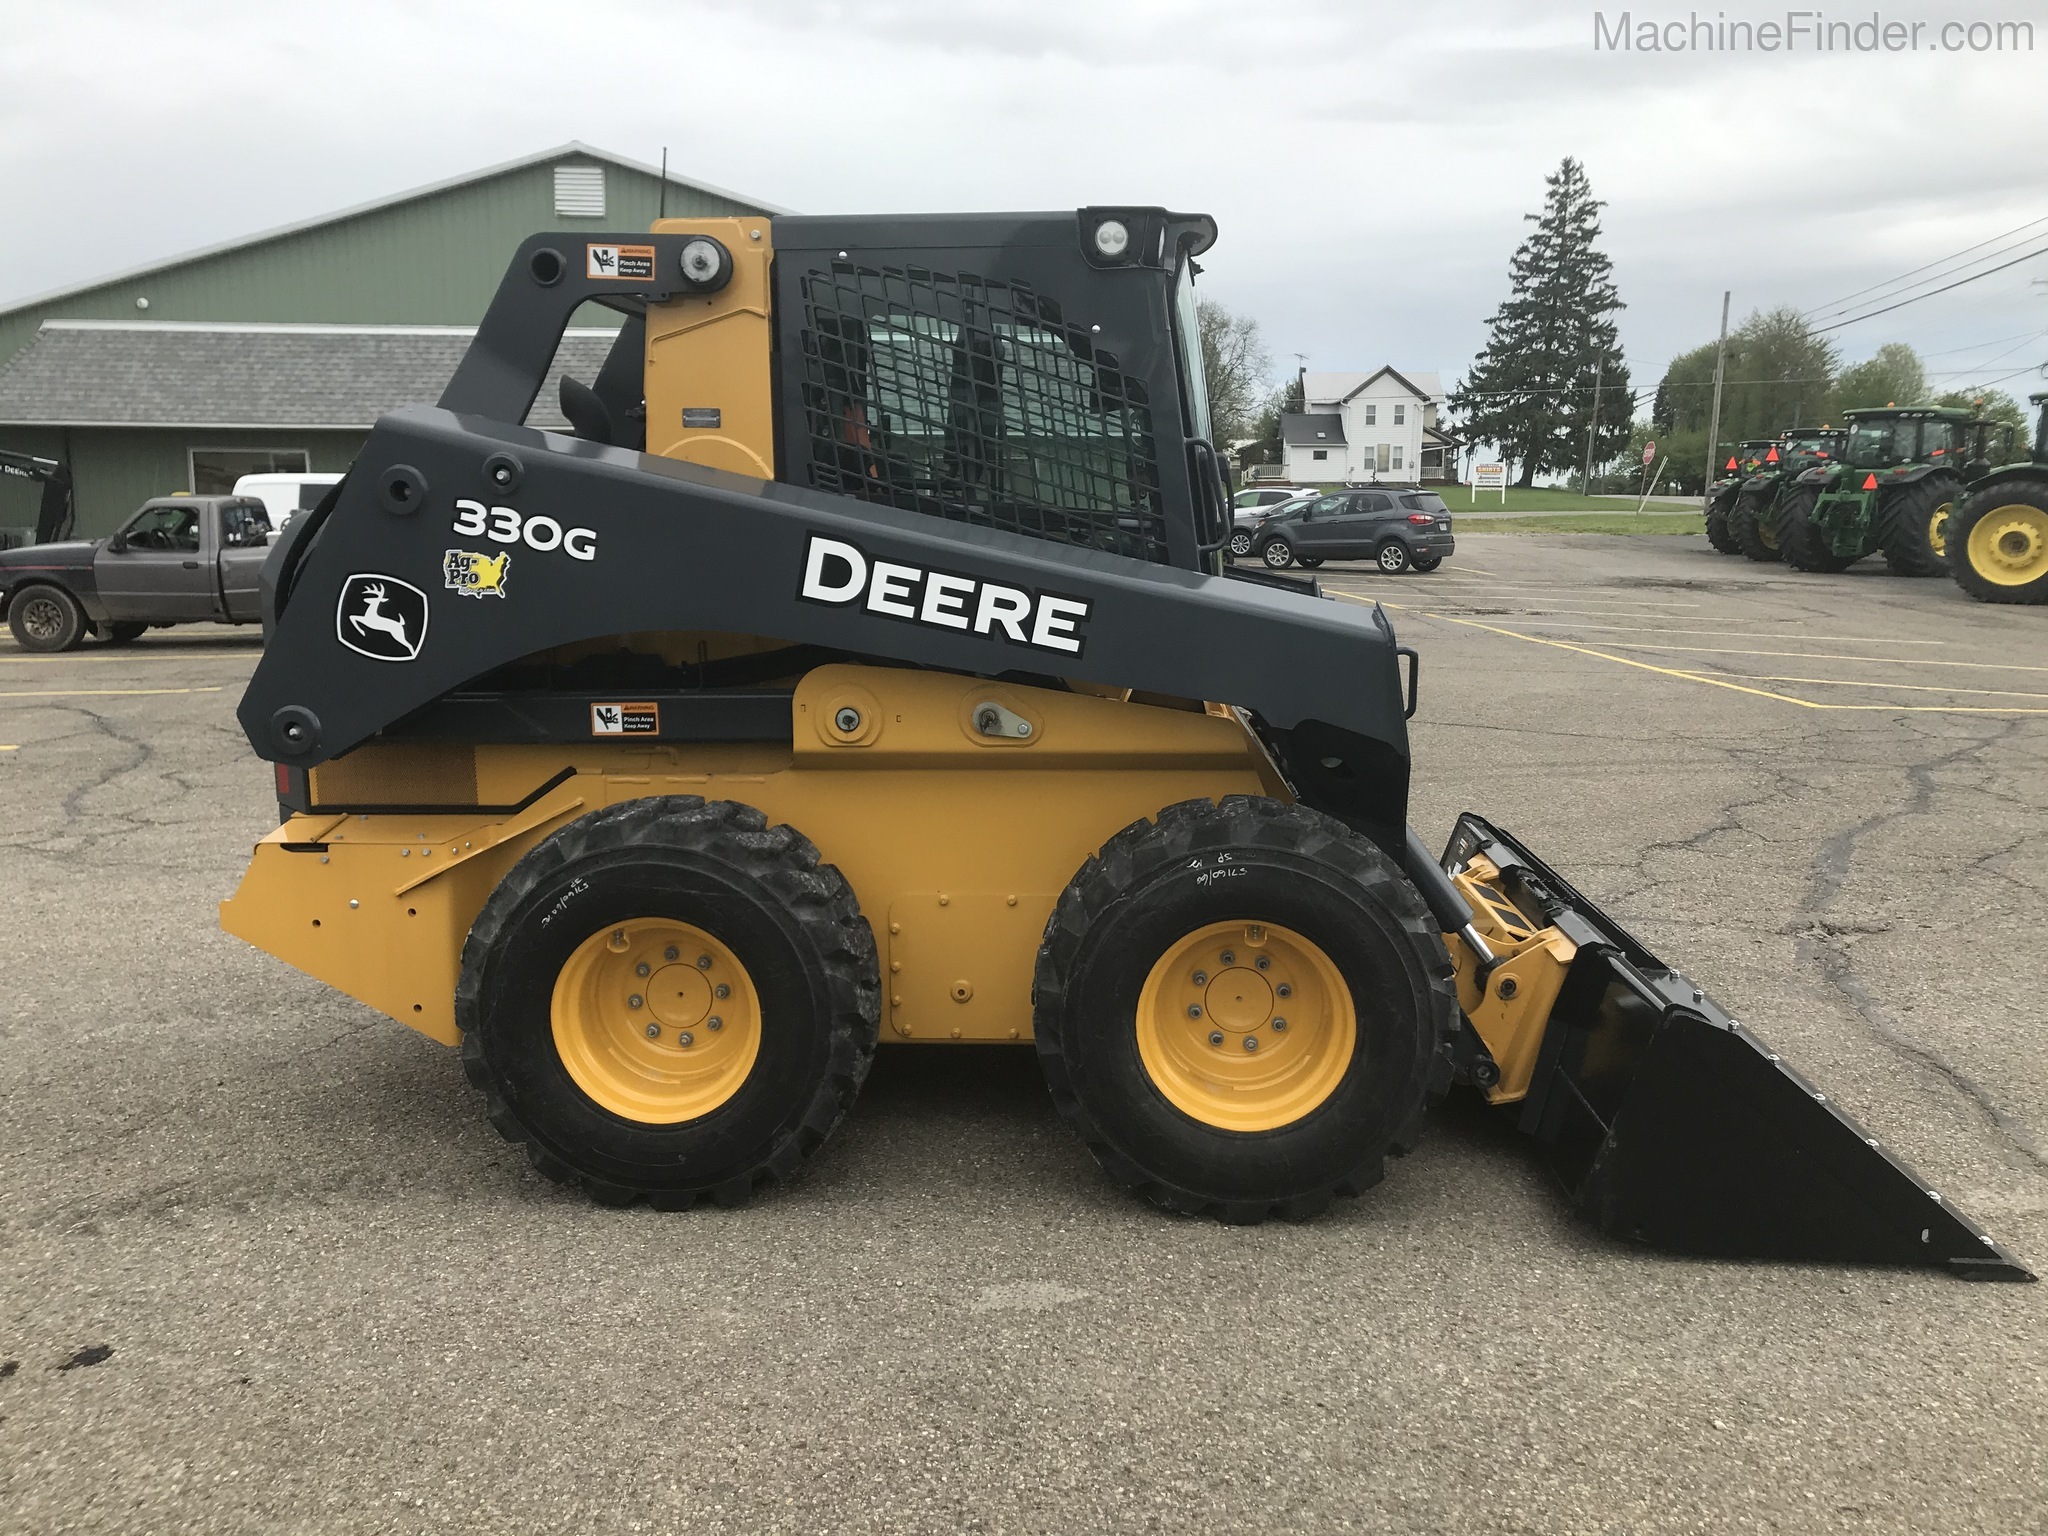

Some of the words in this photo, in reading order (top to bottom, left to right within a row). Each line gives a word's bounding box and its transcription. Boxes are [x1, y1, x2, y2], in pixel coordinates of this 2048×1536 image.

[453, 499, 597, 561] 330G
[448, 552, 477, 571] Ag-
[448, 569, 479, 584] Pro
[802, 536, 1088, 653] DEERE
